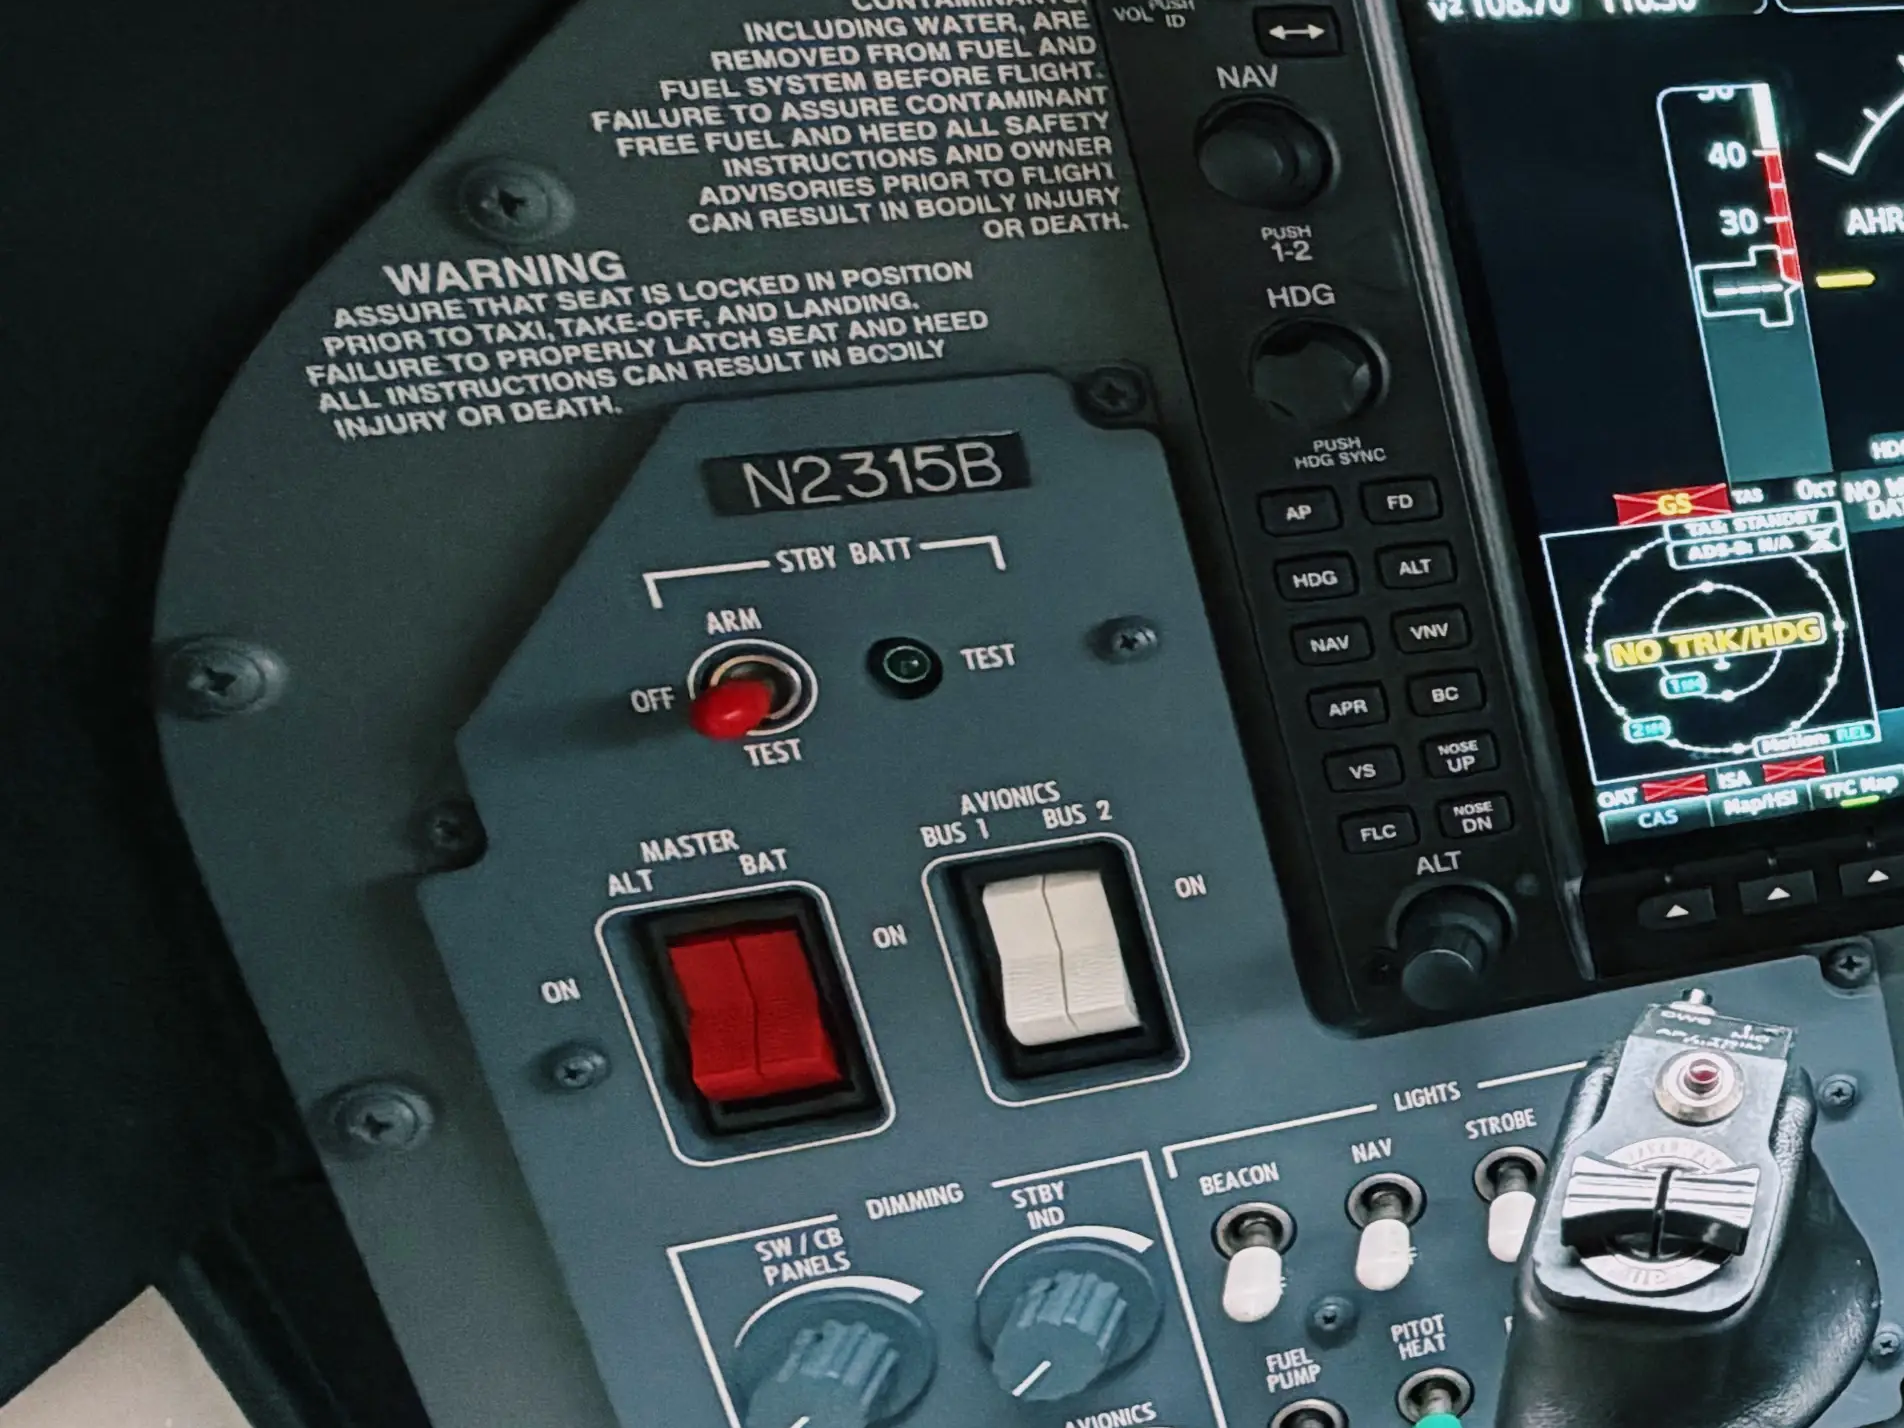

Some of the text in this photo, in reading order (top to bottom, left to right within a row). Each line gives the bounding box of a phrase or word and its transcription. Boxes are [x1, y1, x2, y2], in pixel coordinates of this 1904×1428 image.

[743, 10, 1089, 44] INCLUDING WATER, ARE
[1216, 64, 1278, 89] NAV
[1708, 140, 1747, 169] 40
[1719, 207, 1759, 236] 30
[382, 250, 627, 296] WARNING
[334, 260, 973, 329] ASSURE THAT SEAT IS LOCKED IN POSITION
[1266, 283, 1335, 309] HDG
[322, 291, 920, 357] PRIOR TO TAXI, TAKE-OFF, AND LANDING.
[305, 310, 989, 387] FAILURE TO PROPERLY LATCH SEAT AND HEED
[319, 338, 945, 413] ALL INSTRUCTIONS CAN RESULT IN BODILY
[333, 394, 622, 440] INJURY OR DEATH.
[742, 441, 1002, 508] N2315B
[1286, 504, 1312, 521] AP
[1386, 494, 1413, 510] FD
[775, 536, 911, 573] STBY BATT
[1399, 558, 1431, 576] ALT
[707, 607, 762, 635] ARM
[959, 643, 1015, 670] TEST
[1310, 634, 1349, 653] NAV
[1612, 617, 1822, 667] NO TRK/HDG
[630, 686, 674, 713] OFF
[743, 738, 802, 767] TEST
[961, 780, 1061, 816] AVIONICS
[1042, 799, 1113, 829] BUS 2
[640, 829, 740, 863] MASTER
[919, 818, 989, 848] BUS 1
[738, 848, 788, 876] BAT
[608, 869, 653, 897] ALT
[1174, 874, 1207, 898] ON
[872, 924, 907, 949] ON
[541, 978, 581, 1004] ON
[1393, 1081, 1461, 1112] LIGHTS
[1465, 1107, 1537, 1140] STROBE
[1351, 1137, 1392, 1164] NAV
[1199, 1161, 1280, 1196] BEACON
[865, 1182, 964, 1220] DIMMING
[1011, 1180, 1064, 1209] STBY
[1026, 1206, 1065, 1230] IND
[763, 1250, 851, 1287] PANELS
[1390, 1313, 1445, 1343] PITOT
[1265, 1347, 1314, 1373] FUEL
[1398, 1332, 1446, 1361] HEAT
[1266, 1363, 1321, 1393] PUMP
